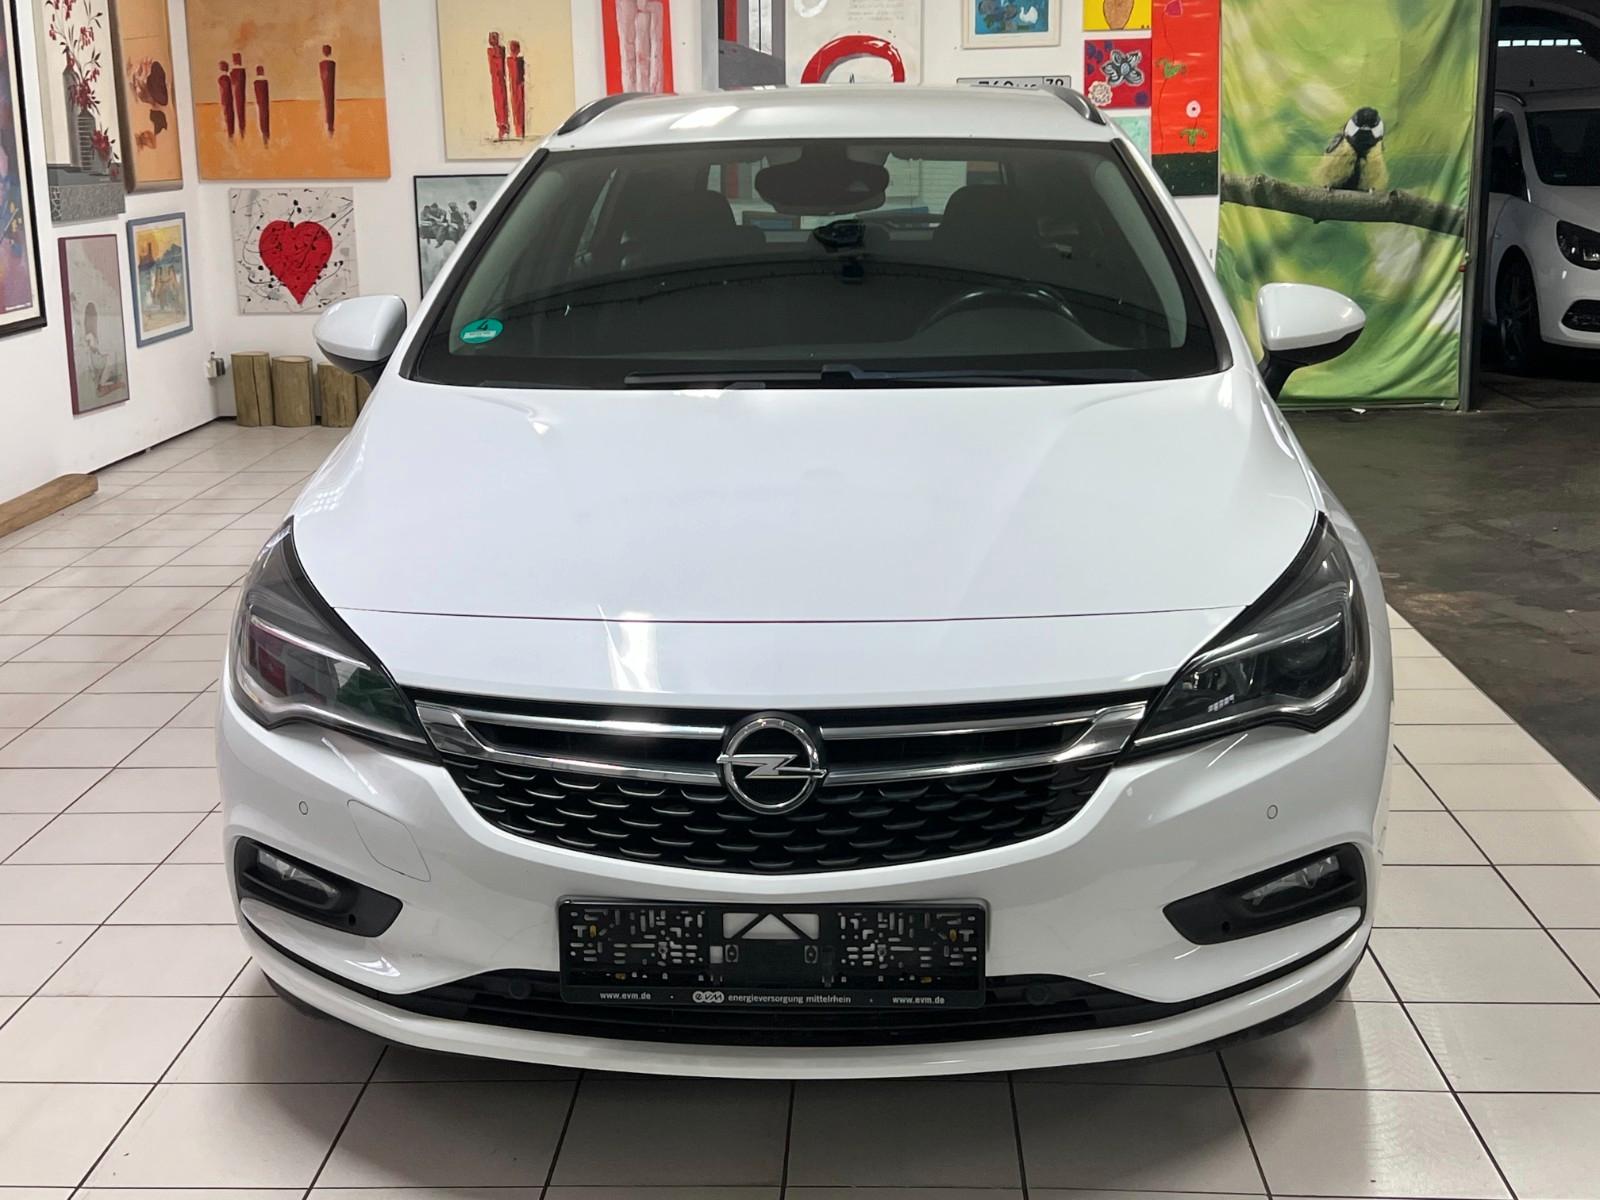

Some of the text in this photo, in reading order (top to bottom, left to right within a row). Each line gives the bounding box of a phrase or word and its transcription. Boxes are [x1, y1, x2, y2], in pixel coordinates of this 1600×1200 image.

[478, 320, 488, 330] 4
[599, 992, 651, 1000] www.evm.de
[728, 993, 804, 1004] energieversorgung
[806, 994, 852, 1003] mittelrhein
[892, 995, 945, 1005] www.evm.de
